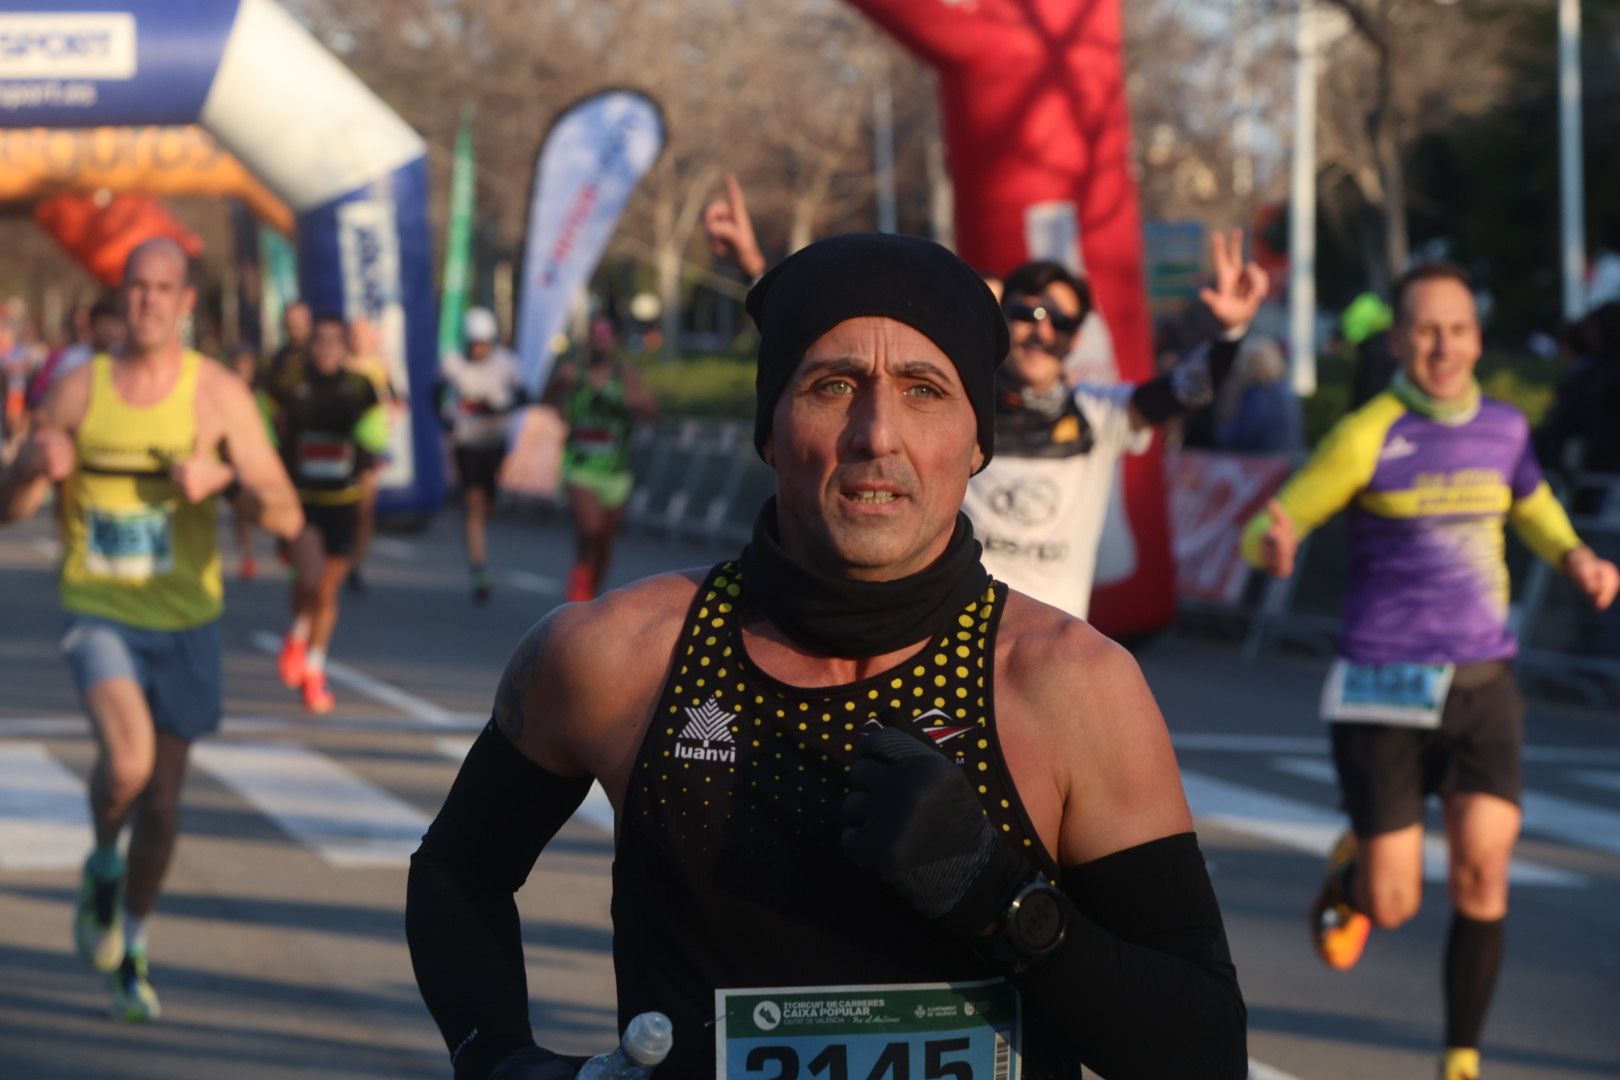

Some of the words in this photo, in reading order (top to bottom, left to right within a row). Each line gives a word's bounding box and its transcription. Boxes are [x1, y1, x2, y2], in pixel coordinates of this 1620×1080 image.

[674, 742, 736, 763] luanvi
[826, 1000, 837, 1008] DE
[783, 1008, 819, 1018] CAIXA
[820, 1007, 870, 1017] POPULAR
